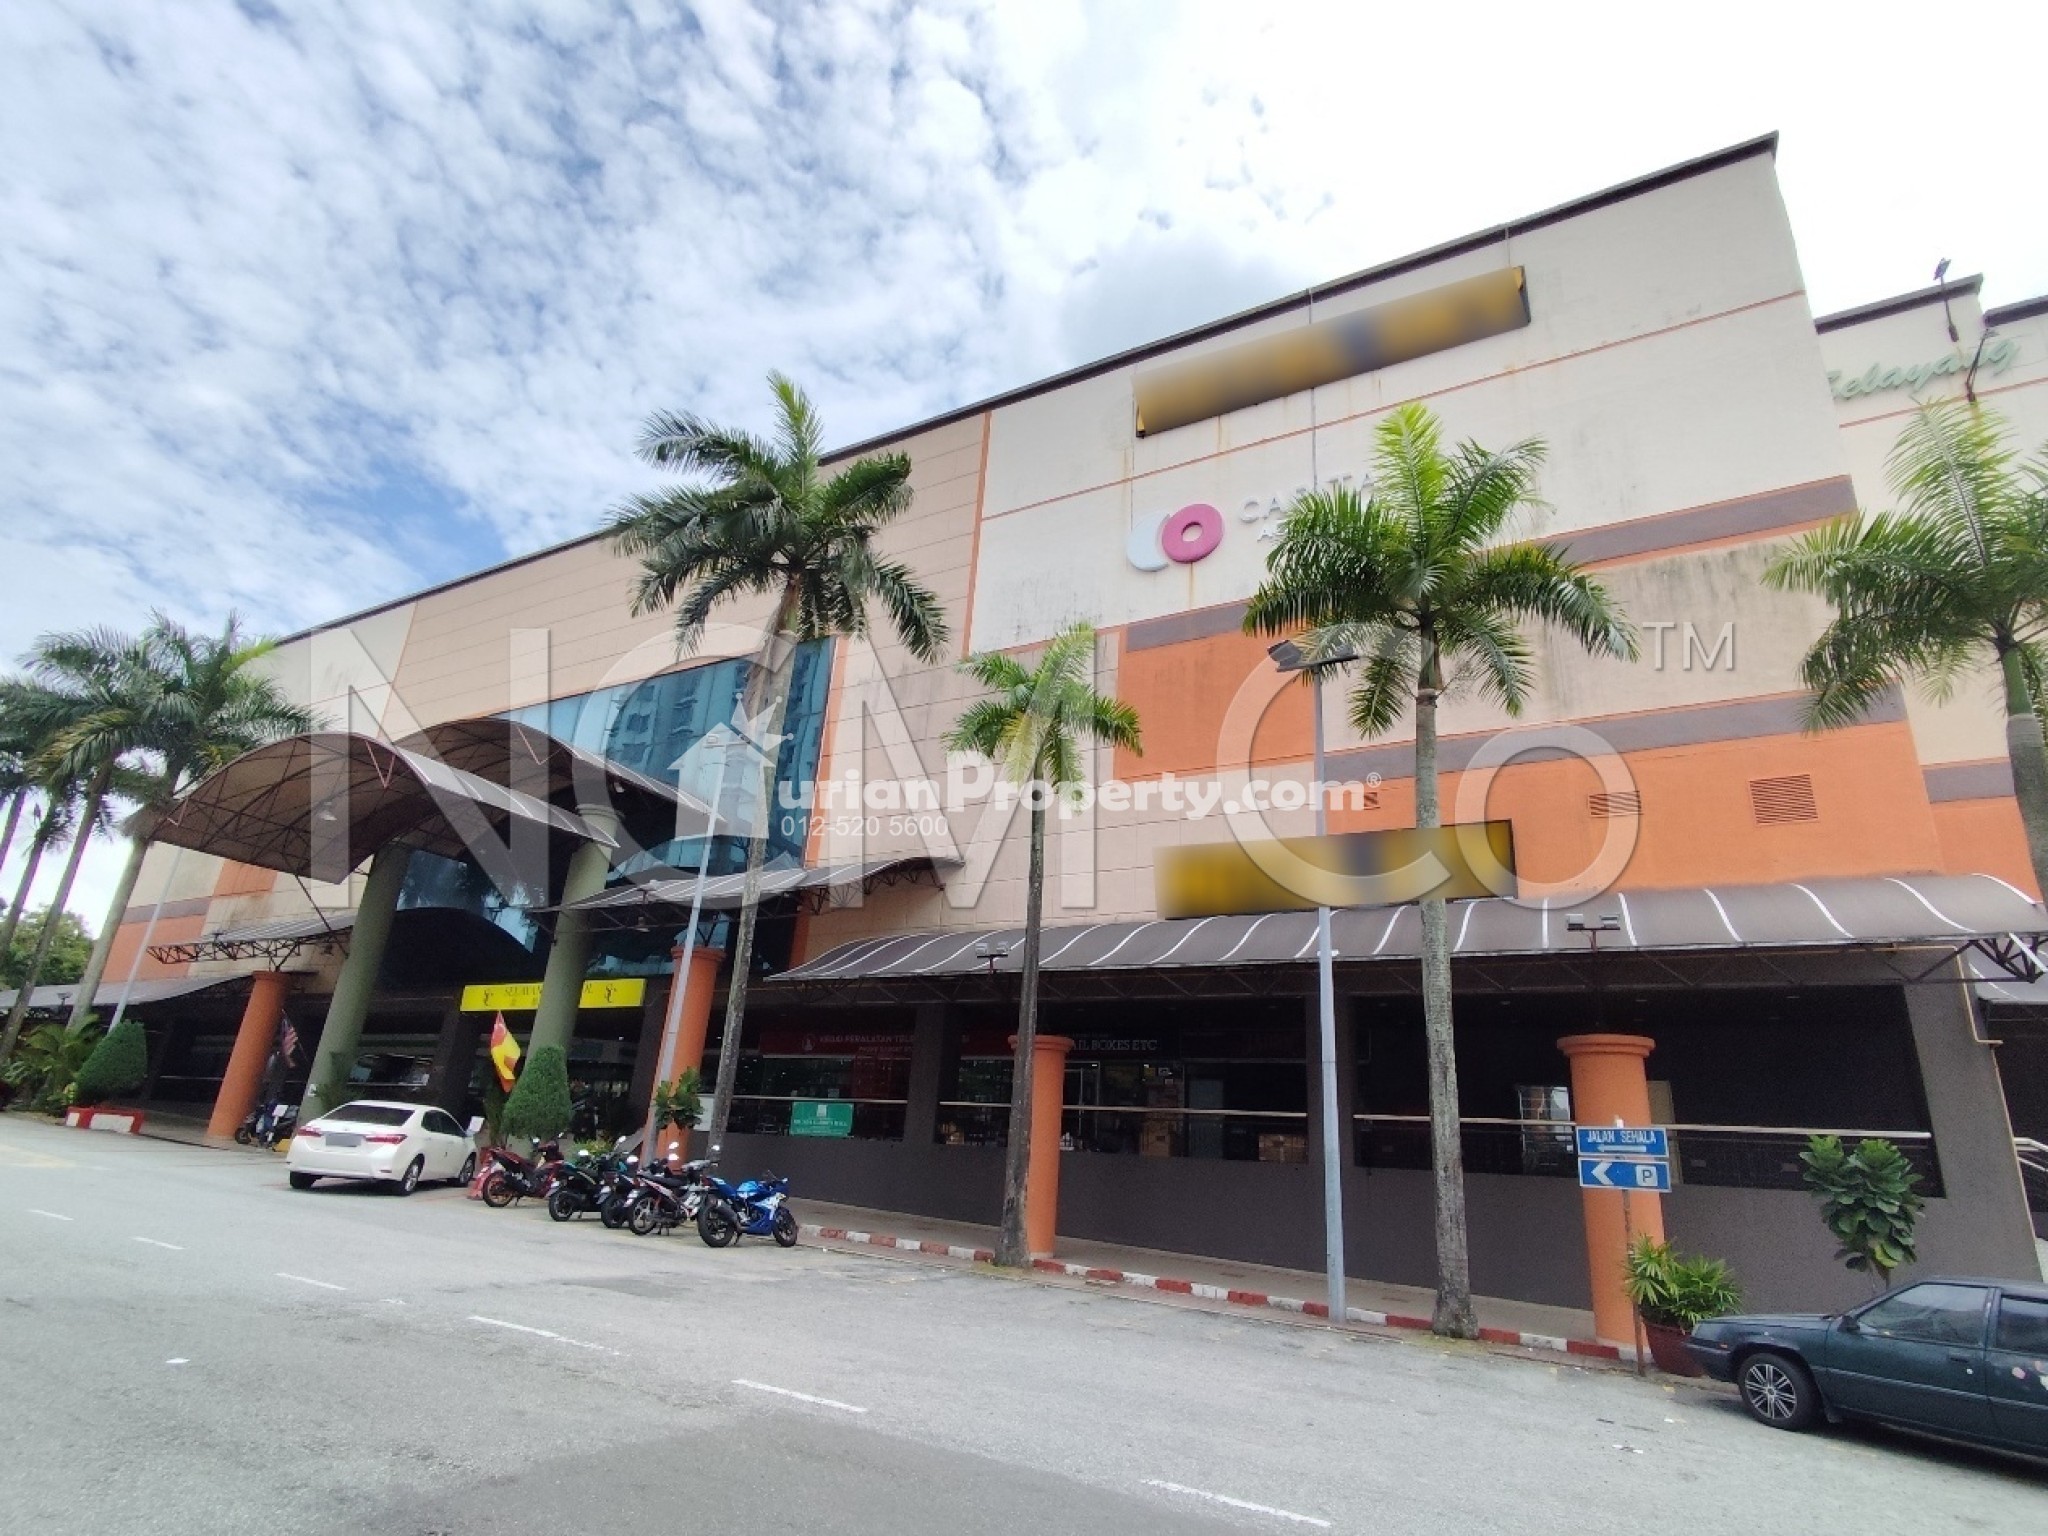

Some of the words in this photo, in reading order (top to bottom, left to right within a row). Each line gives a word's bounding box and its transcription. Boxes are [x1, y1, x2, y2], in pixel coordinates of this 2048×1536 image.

[1091, 1039, 1131, 1051] BOXES
[1132, 1039, 1158, 1051] ETC
[1587, 1130, 1615, 1143] JALAN
[1621, 1130, 1657, 1144] SEHALA
[1642, 1169, 1653, 1184] P
